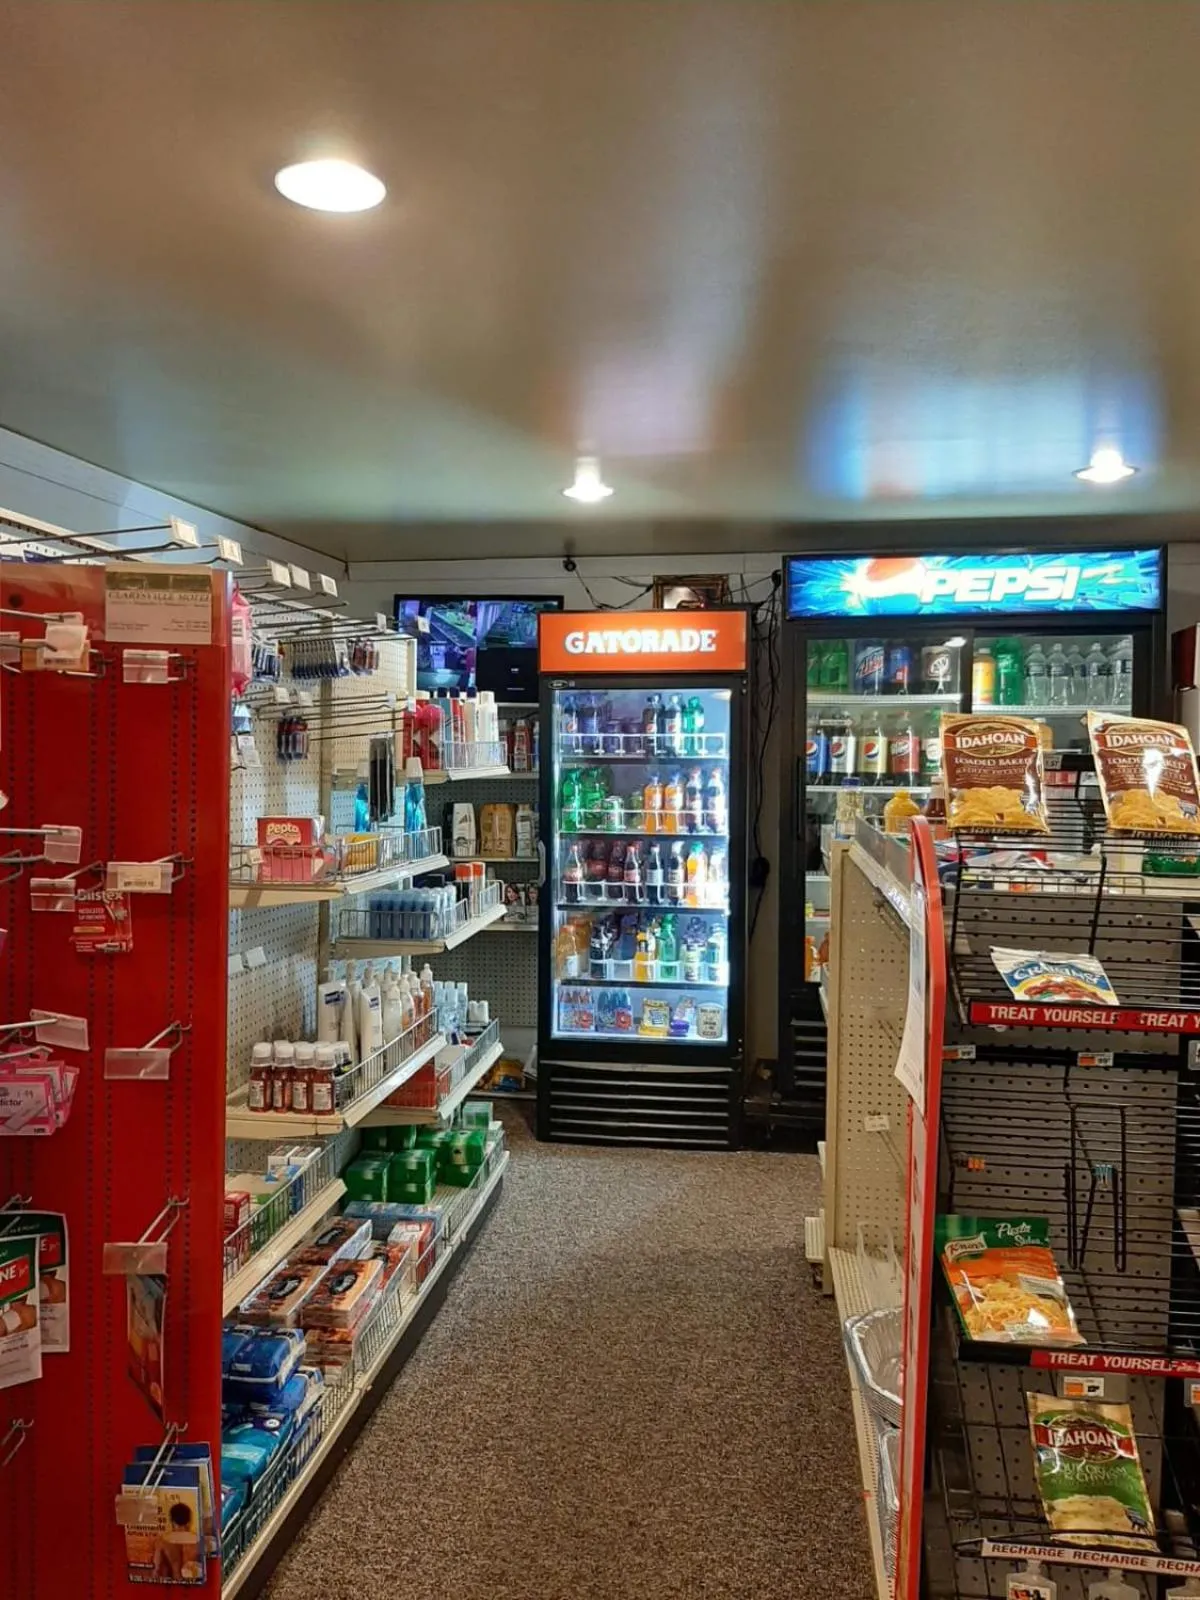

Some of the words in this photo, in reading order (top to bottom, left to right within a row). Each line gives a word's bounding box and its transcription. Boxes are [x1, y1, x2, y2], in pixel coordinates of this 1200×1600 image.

[920, 565, 1082, 604] PEPSI
[565, 628, 718, 654] GATORADE
[955, 732, 1026, 748] IDAHOAN
[1106, 734, 1176, 747] IDAHOAN
[954, 756, 996, 766] LOADED
[998, 756, 1034, 766] BAKED
[267, 822, 299, 835] Pepto
[989, 1005, 1039, 1020] TREAT
[1042, 1008, 1120, 1025] YOURSELF
[995, 1221, 1032, 1239] Pasta
[1048, 1352, 1098, 1367] TREAT
[1047, 1429, 1118, 1448] IDAHOAN
[991, 1543, 1065, 1559] RECHARGE
[1072, 1551, 1149, 1567] RECHARGE
